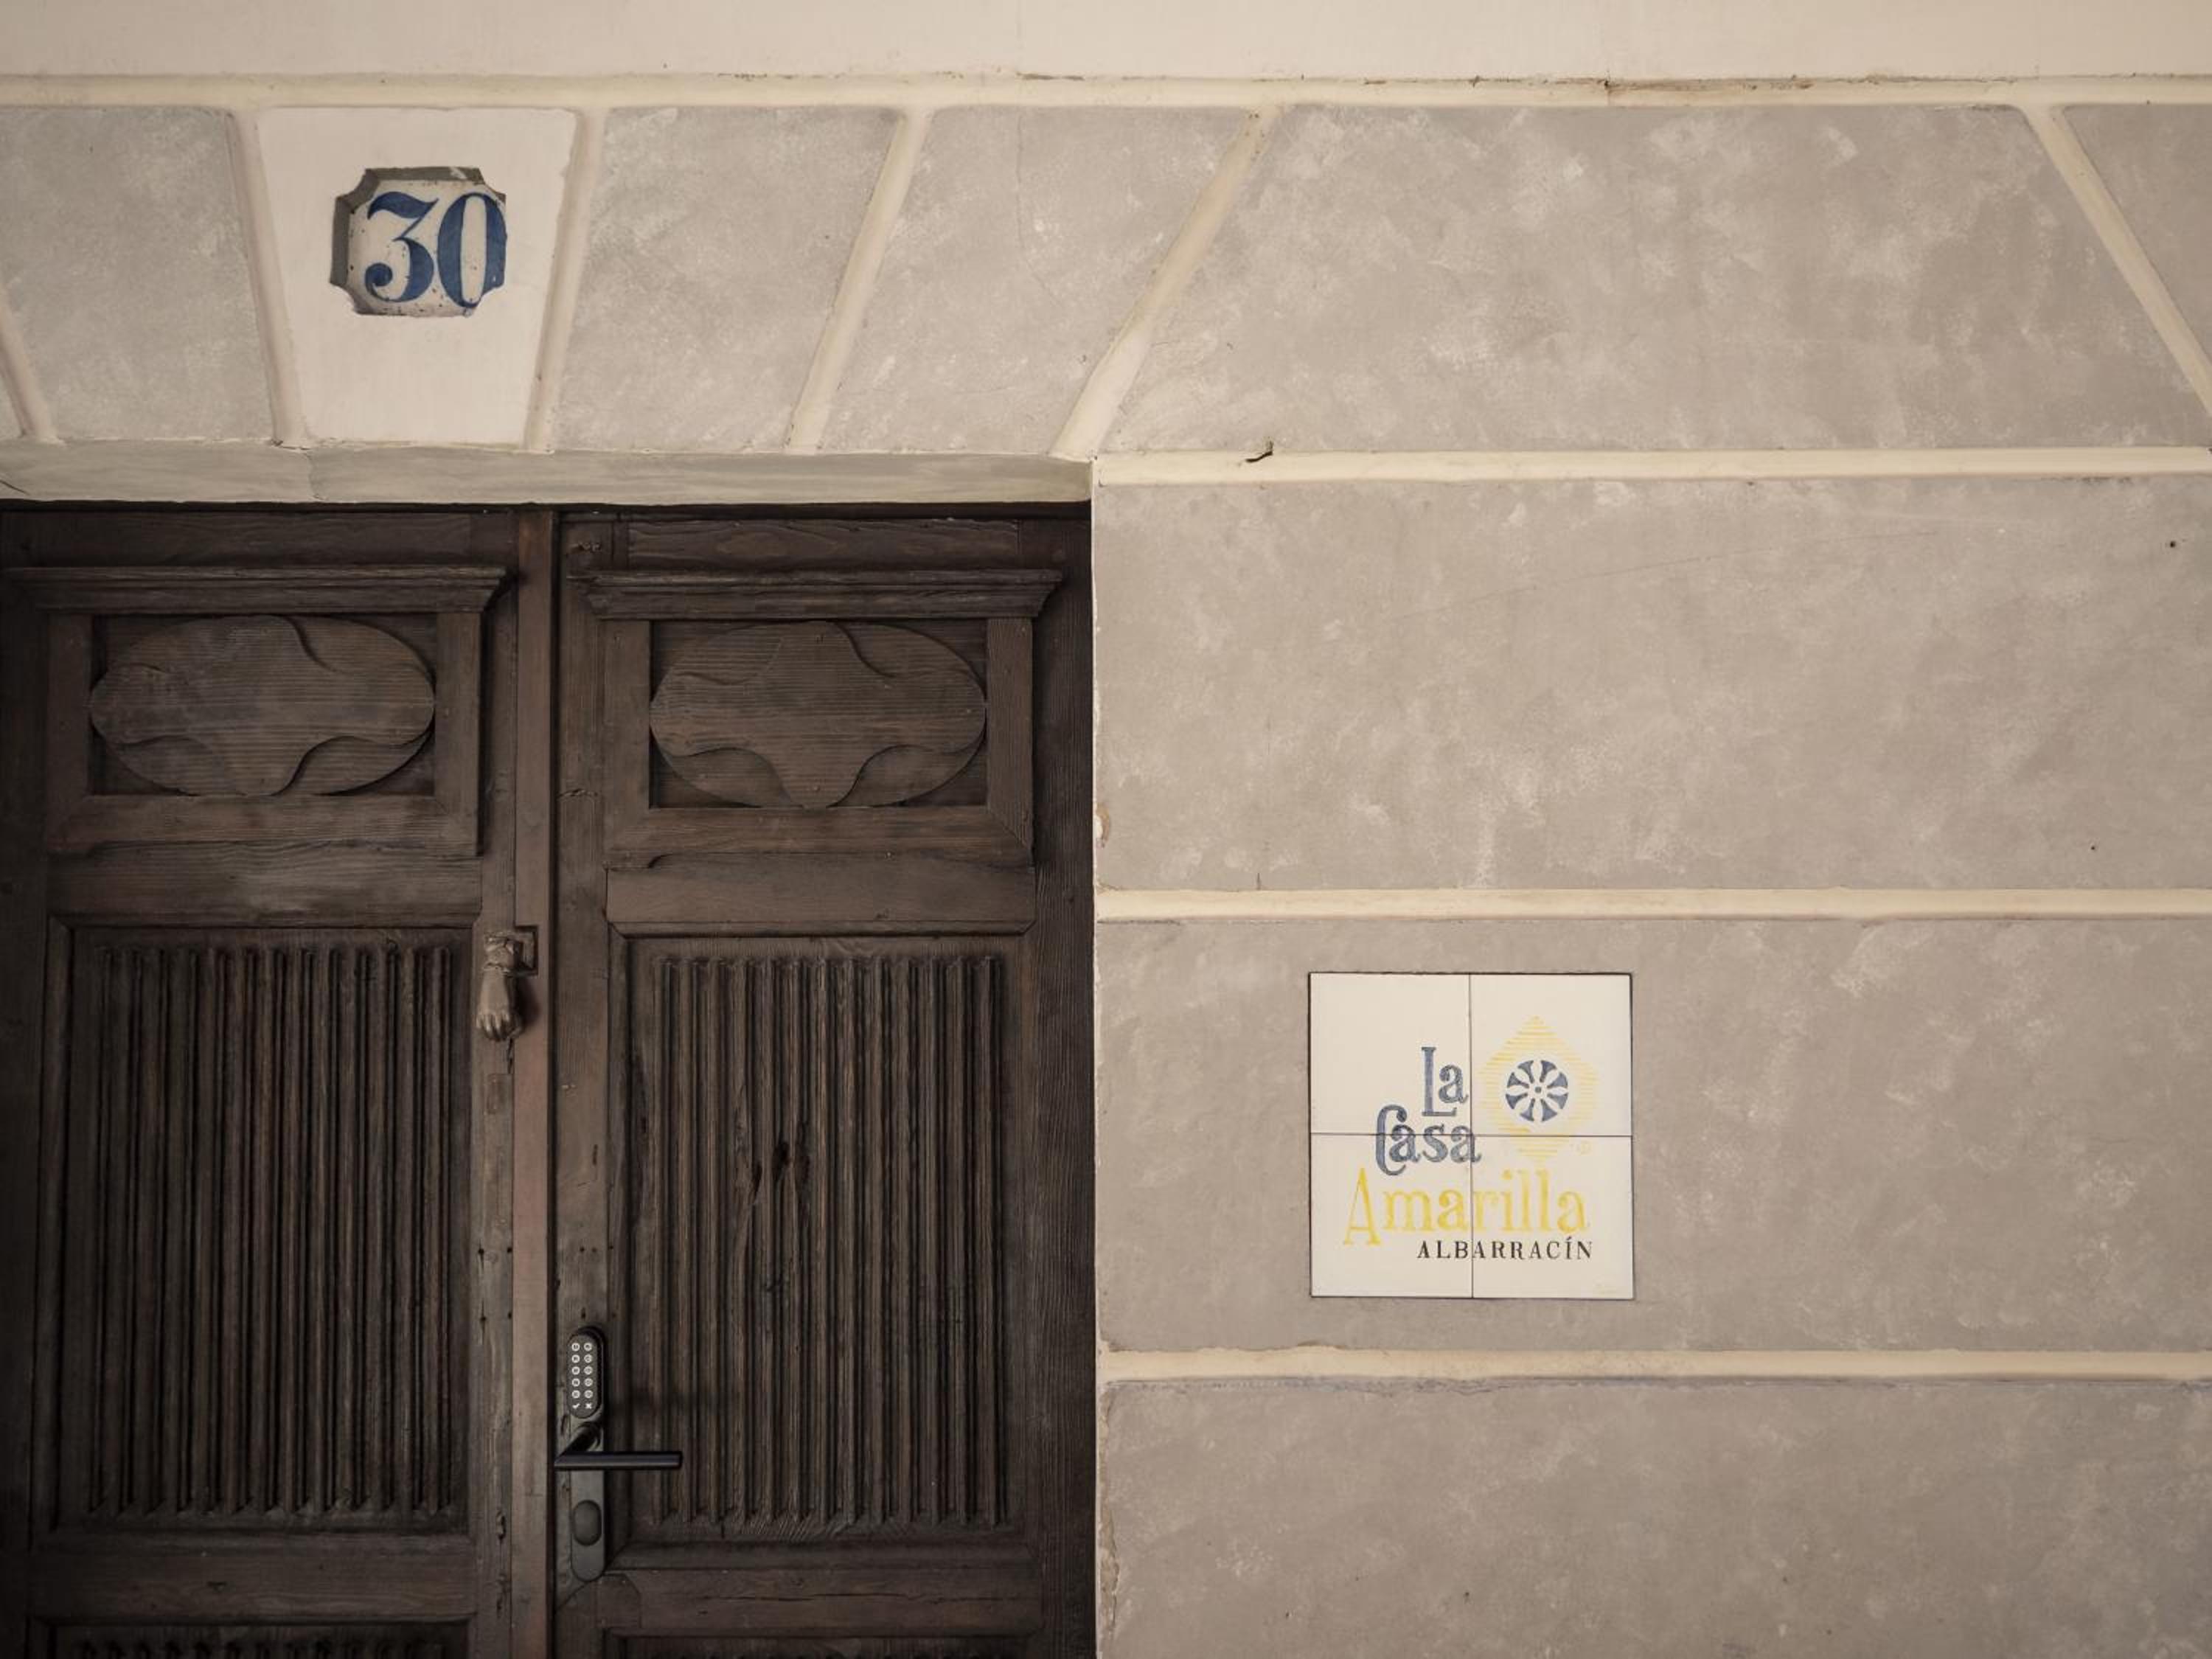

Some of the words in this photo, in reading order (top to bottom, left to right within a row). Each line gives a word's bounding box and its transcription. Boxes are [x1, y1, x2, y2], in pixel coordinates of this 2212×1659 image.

[365, 191, 507, 308] 30
[1421, 1046, 1469, 1117] La
[1376, 1104, 1482, 1176] Casa
[1343, 1167, 1590, 1246] Amarilla
[1417, 1237, 1593, 1260] ALBARRACÍN
